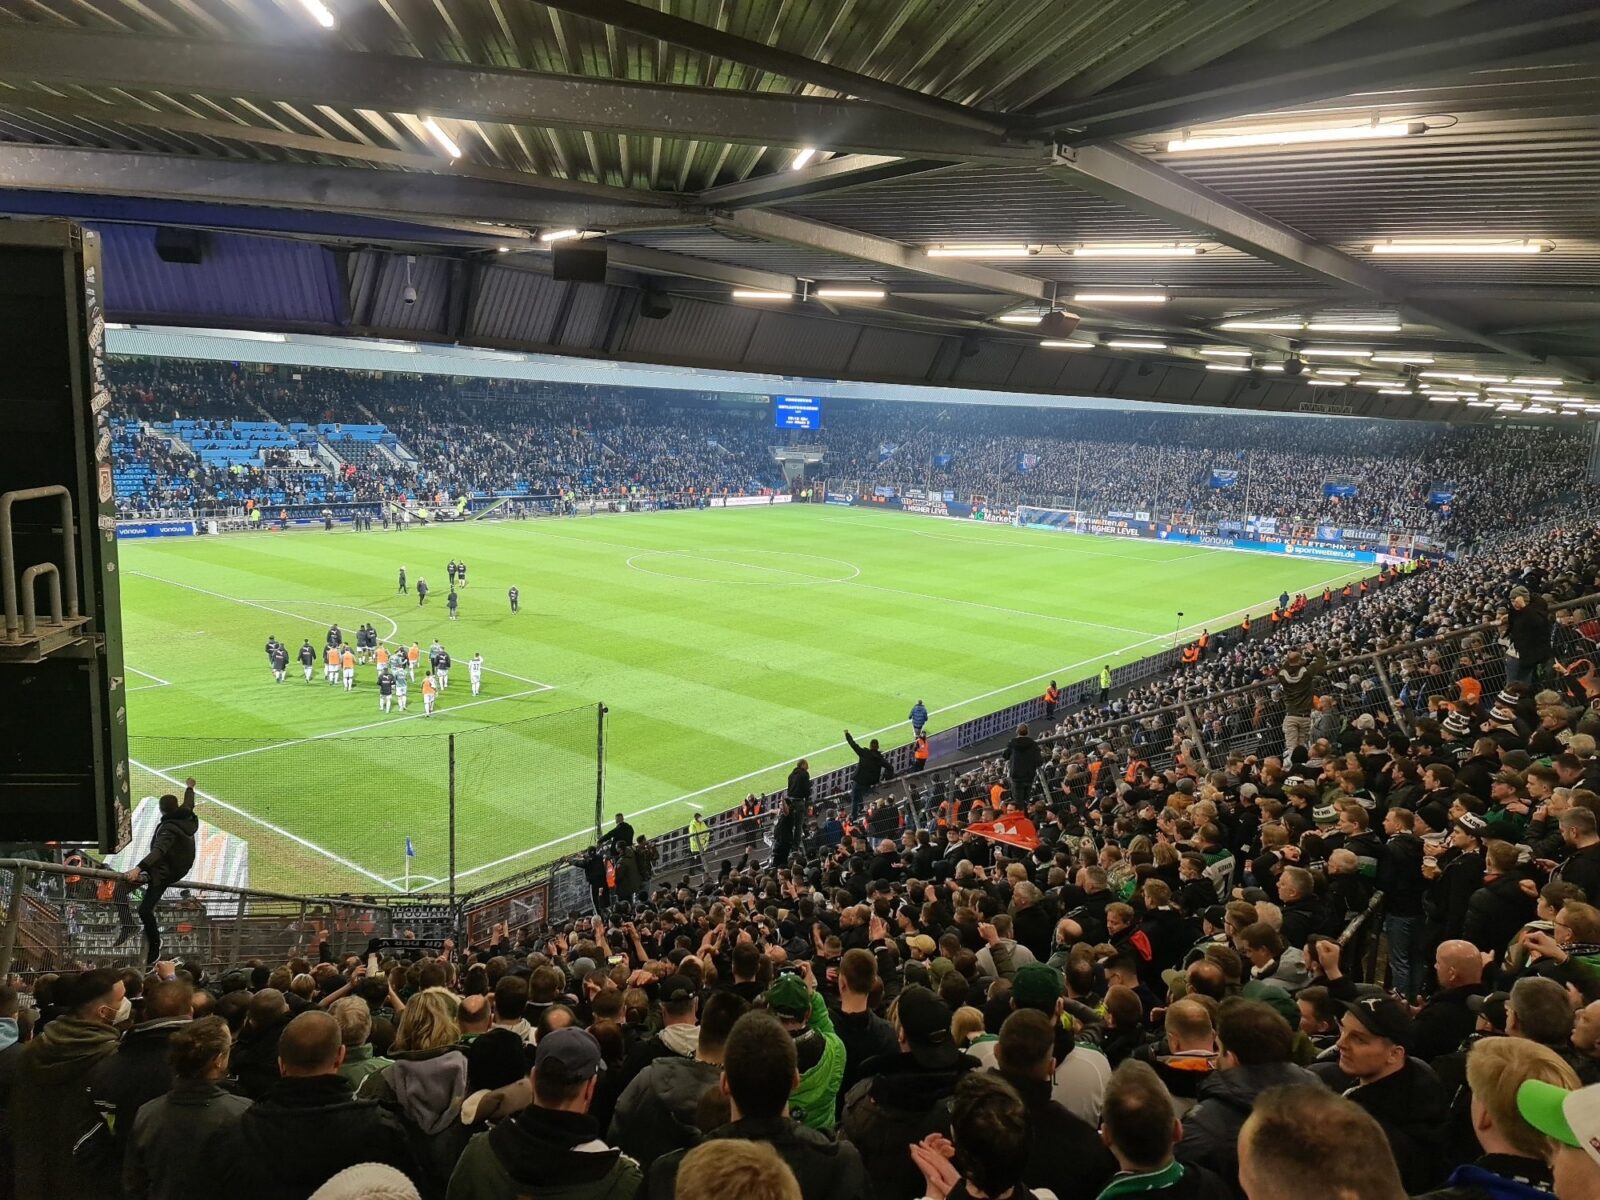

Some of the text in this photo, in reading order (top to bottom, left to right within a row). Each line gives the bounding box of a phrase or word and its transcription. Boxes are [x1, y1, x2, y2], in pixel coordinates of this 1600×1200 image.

[931, 507, 949, 516] LEVEL
[1088, 525, 1115, 533] HIGHER
[1117, 527, 1139, 536] LEVEL
[1342, 529, 1376, 540] Witten
[1295, 546, 1356, 558] sportwetten.de
